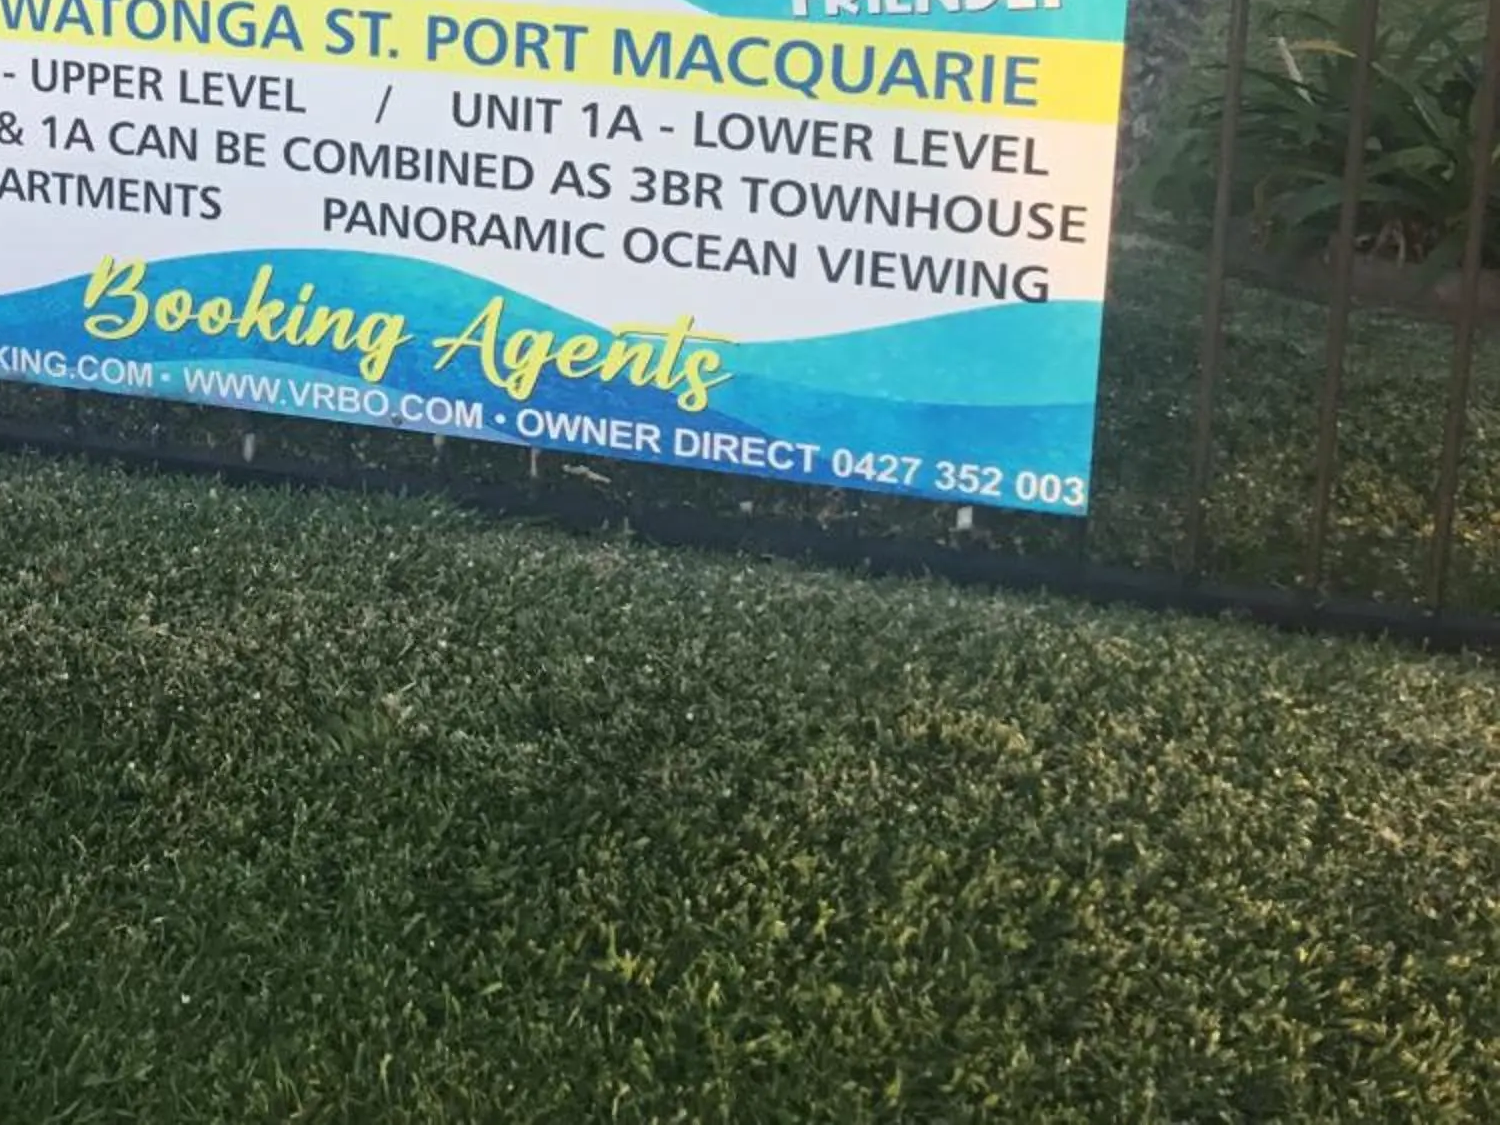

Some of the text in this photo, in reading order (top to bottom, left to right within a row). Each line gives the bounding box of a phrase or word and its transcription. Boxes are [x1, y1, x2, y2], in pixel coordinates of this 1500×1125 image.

[30, 58, 164, 103] UPPER
[178, 69, 306, 113] LEVEL
[452, 91, 562, 135] UNIT
[581, 101, 643, 142] 1A
[693, 110, 873, 161] LOWER
[893, 125, 1049, 176] LEVEL
[324, 8, 399, 58] ST.
[427, 15, 588, 71] PORT
[612, 28, 1040, 106] MACQUARIE
[40, 114, 93, 152] 1A
[108, 121, 197, 161] CAN
[215, 131, 266, 167] BE
[283, 134, 534, 191] COMBINED
[550, 159, 611, 199] AS
[630, 167, 723, 211] 3BR
[740, 176, 1087, 244] TOWNHOUSE
[323, 197, 605, 259] PANORAMIC
[622, 227, 797, 278] OCEAN
[818, 245, 1049, 303] VIEWING
[83, 254, 740, 412] Booking Agents
[184, 367, 483, 431] WWW.VRBO.COM
[516, 408, 660, 453] OWNER
[674, 429, 819, 475] DIRECT
[832, 448, 920, 485] 0427
[935, 461, 1003, 497] 352
[1016, 471, 1085, 508] 003
